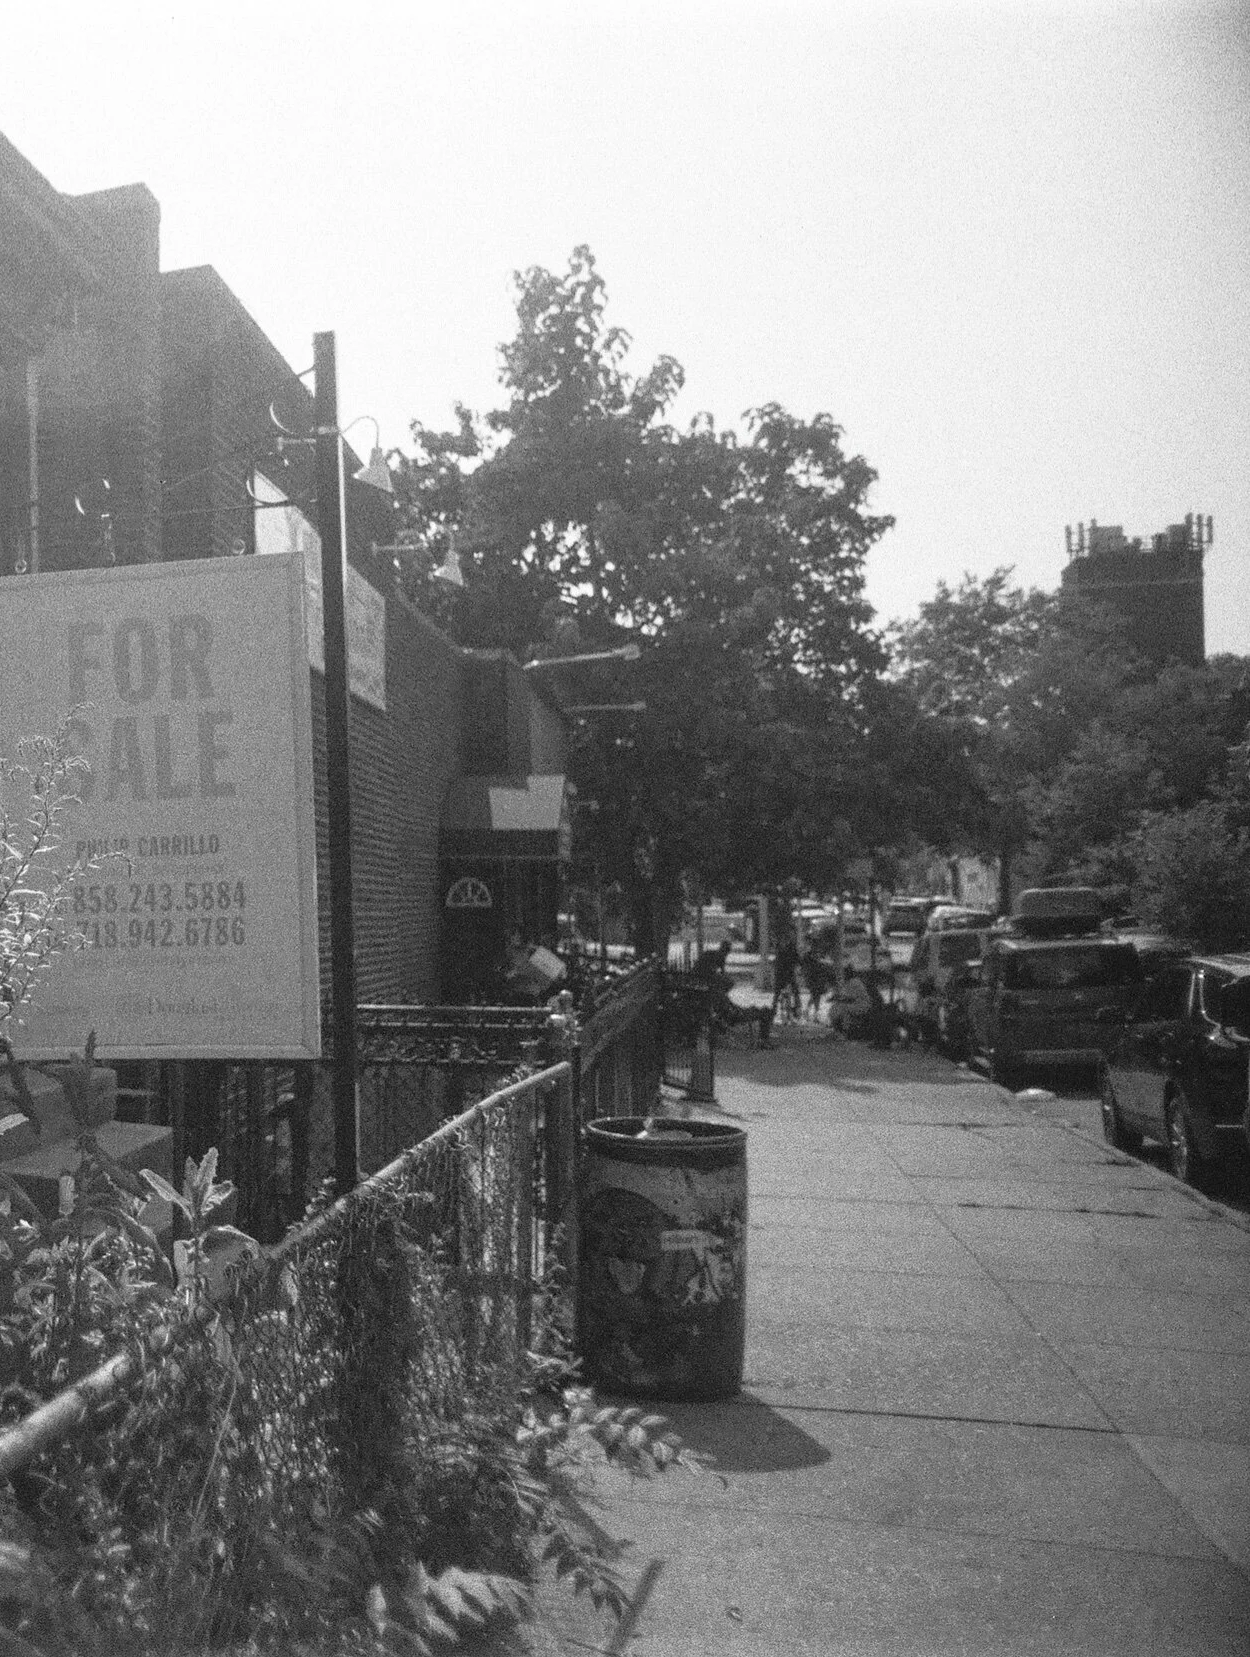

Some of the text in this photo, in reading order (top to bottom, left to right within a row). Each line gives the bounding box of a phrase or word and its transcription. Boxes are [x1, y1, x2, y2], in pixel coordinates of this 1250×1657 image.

[68, 614, 214, 703] FOR
[57, 709, 236, 801] SALE
[138, 834, 220, 856] CARRILLO
[73, 880, 246, 913] 858.243.5884
